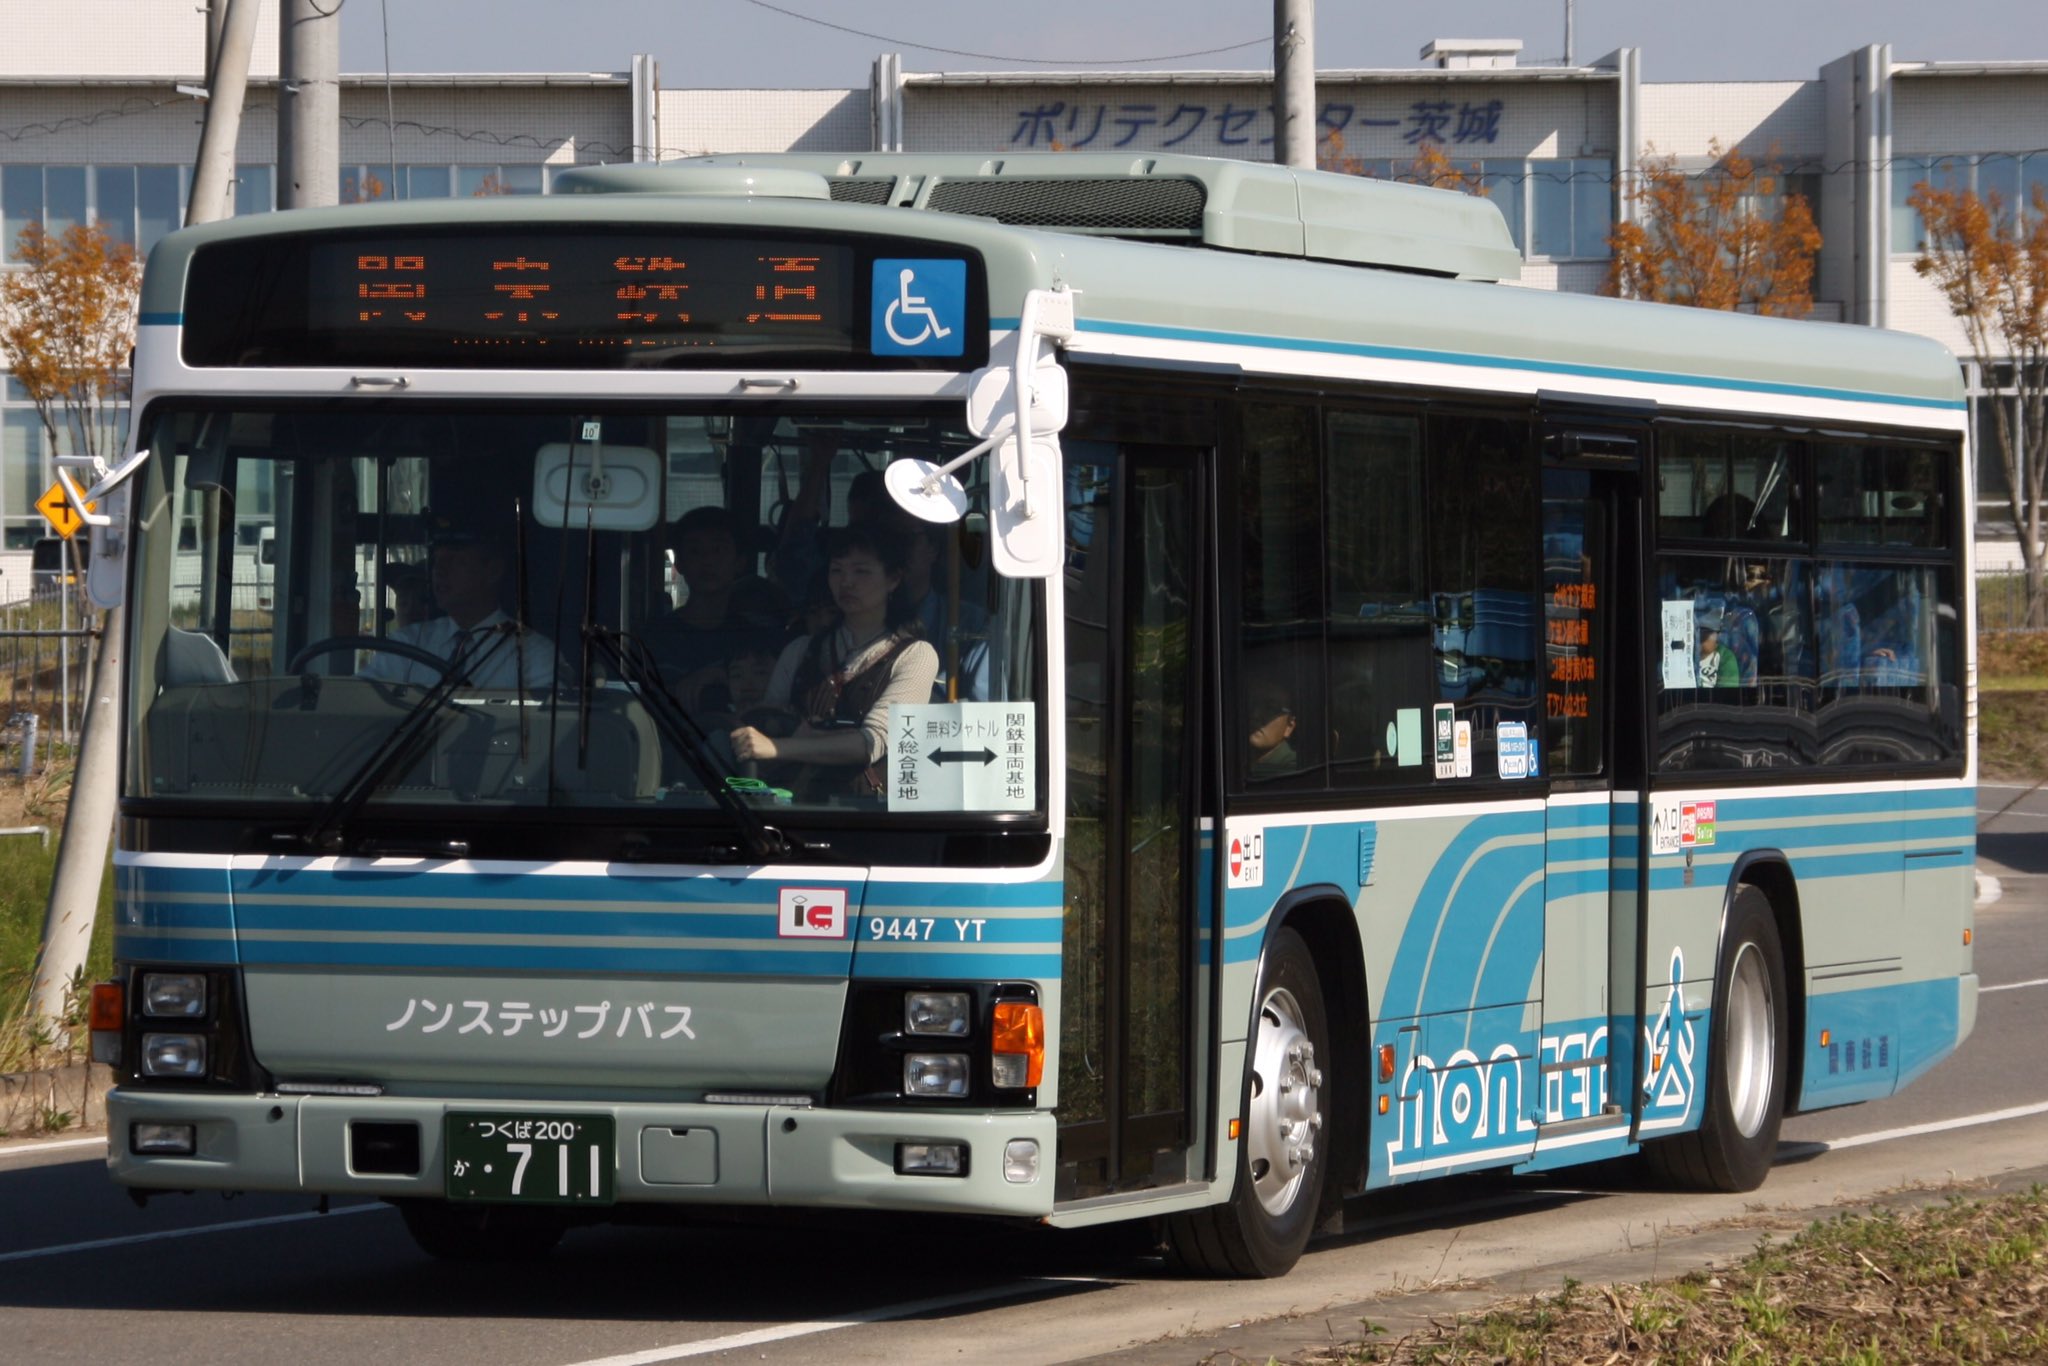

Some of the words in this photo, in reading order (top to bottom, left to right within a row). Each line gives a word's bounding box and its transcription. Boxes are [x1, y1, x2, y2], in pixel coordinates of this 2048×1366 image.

[926, 720, 999, 738] 無料シャトル
[1006, 713, 1025, 799] 関鉄車両基地
[1244, 834, 1261, 861] 出口
[1245, 866, 1258, 881] EXIT
[870, 918, 935, 941] 9447
[955, 919, 986, 942] YT
[386, 999, 696, 1039] ノンステップバス
[453, 1160, 471, 1177] か
